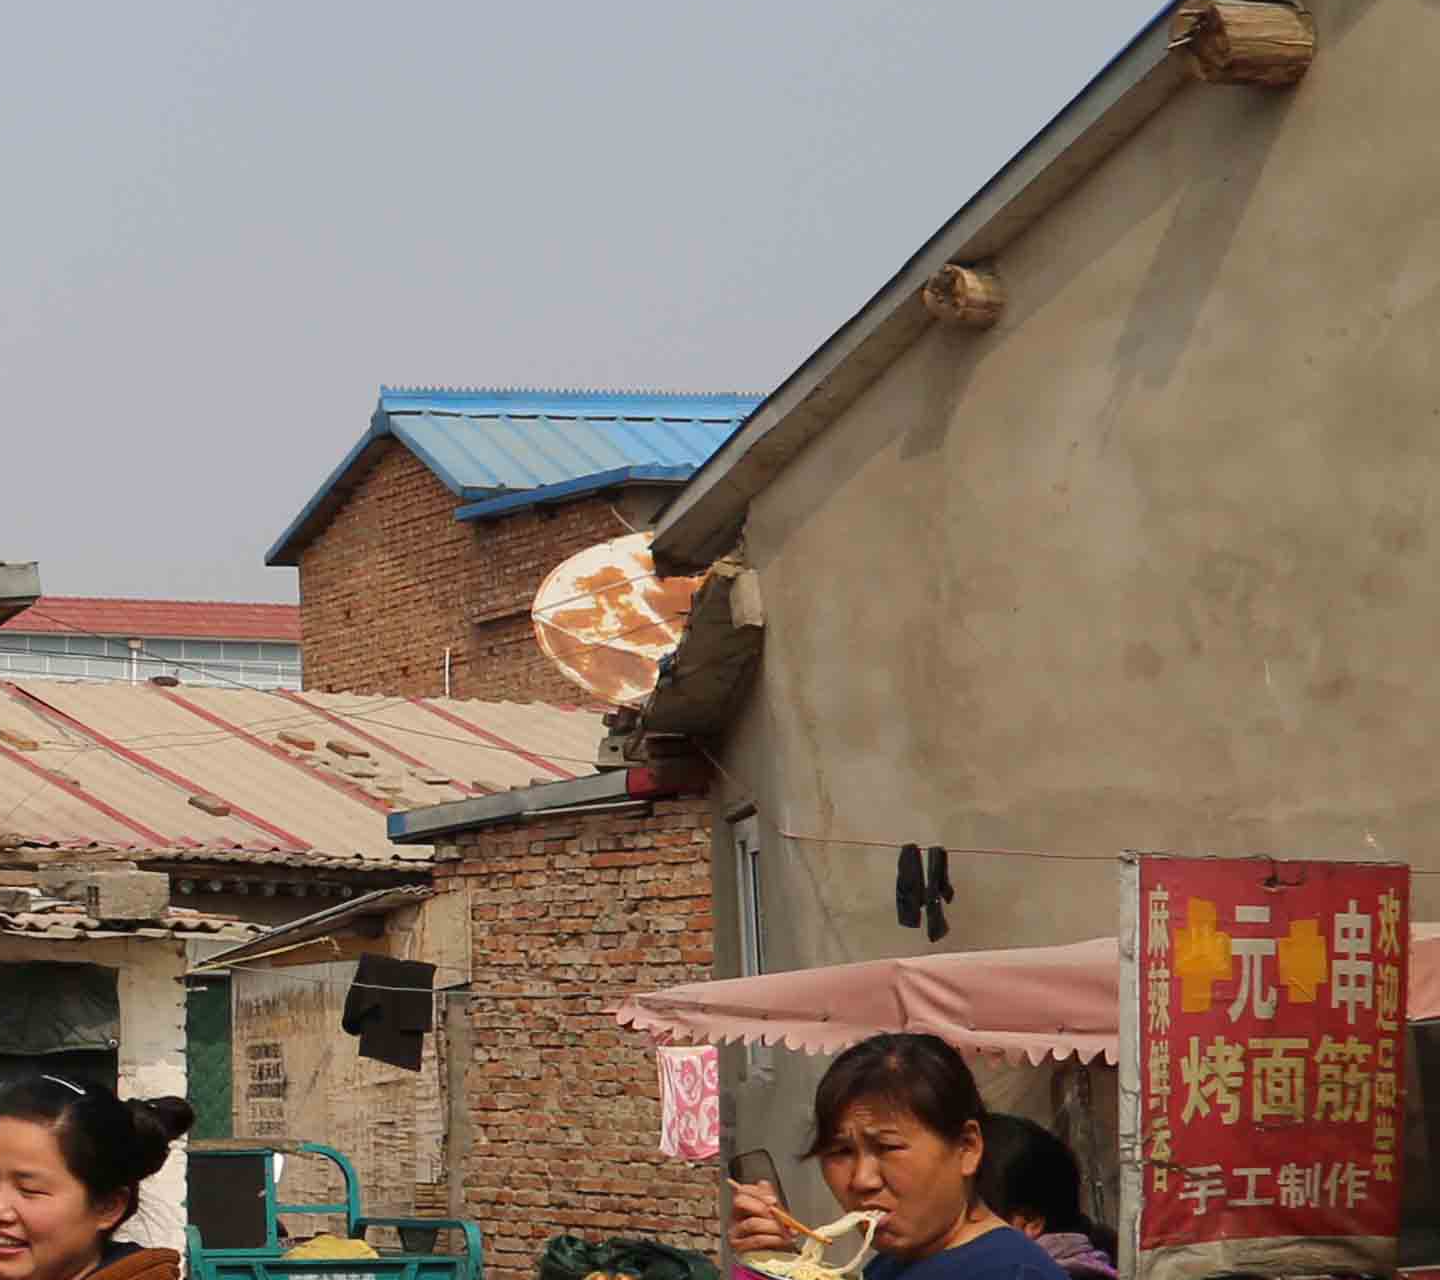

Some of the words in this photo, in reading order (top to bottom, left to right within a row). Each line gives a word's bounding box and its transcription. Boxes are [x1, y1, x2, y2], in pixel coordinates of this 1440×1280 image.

[1180, 1035, 1373, 1125] 烤面筋
[1178, 1163, 1371, 1216] 手工制作
